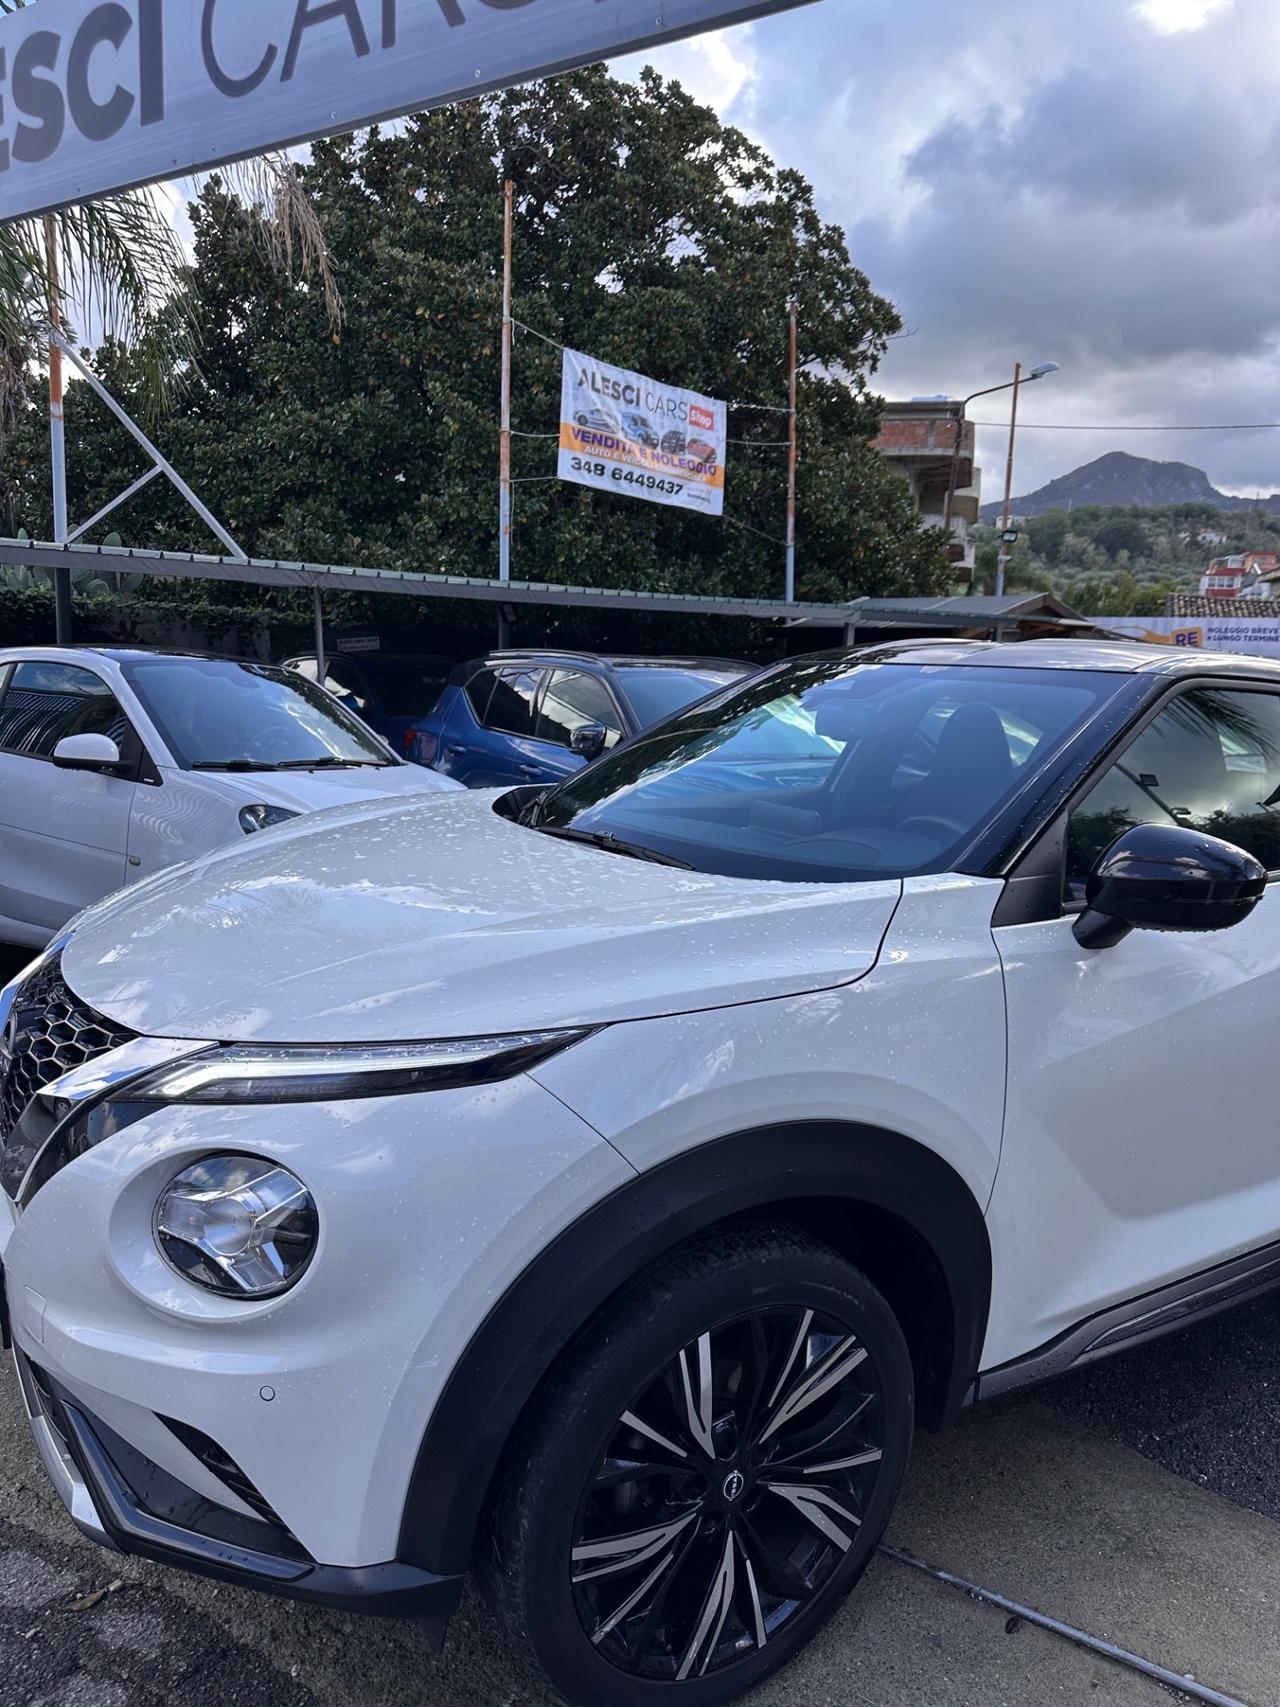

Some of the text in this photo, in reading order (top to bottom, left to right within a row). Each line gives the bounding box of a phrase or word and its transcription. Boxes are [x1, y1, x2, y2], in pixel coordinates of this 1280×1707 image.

[0, 0, 165, 172] SCI
[577, 368, 711, 429] ALESCI CARS shop
[572, 426, 636, 455] VENDITA
[639, 447, 648, 460] E
[651, 451, 717, 476] NOLEGGIO
[584, 445, 611, 458] AUTO
[571, 457, 606, 476] 348
[611, 467, 683, 495] 6449437
[1175, 631, 1198, 646] RE
[1207, 626, 1279, 635] NOLEGGIO BREVE
[1244, 635, 1279, 643] TERMINE
